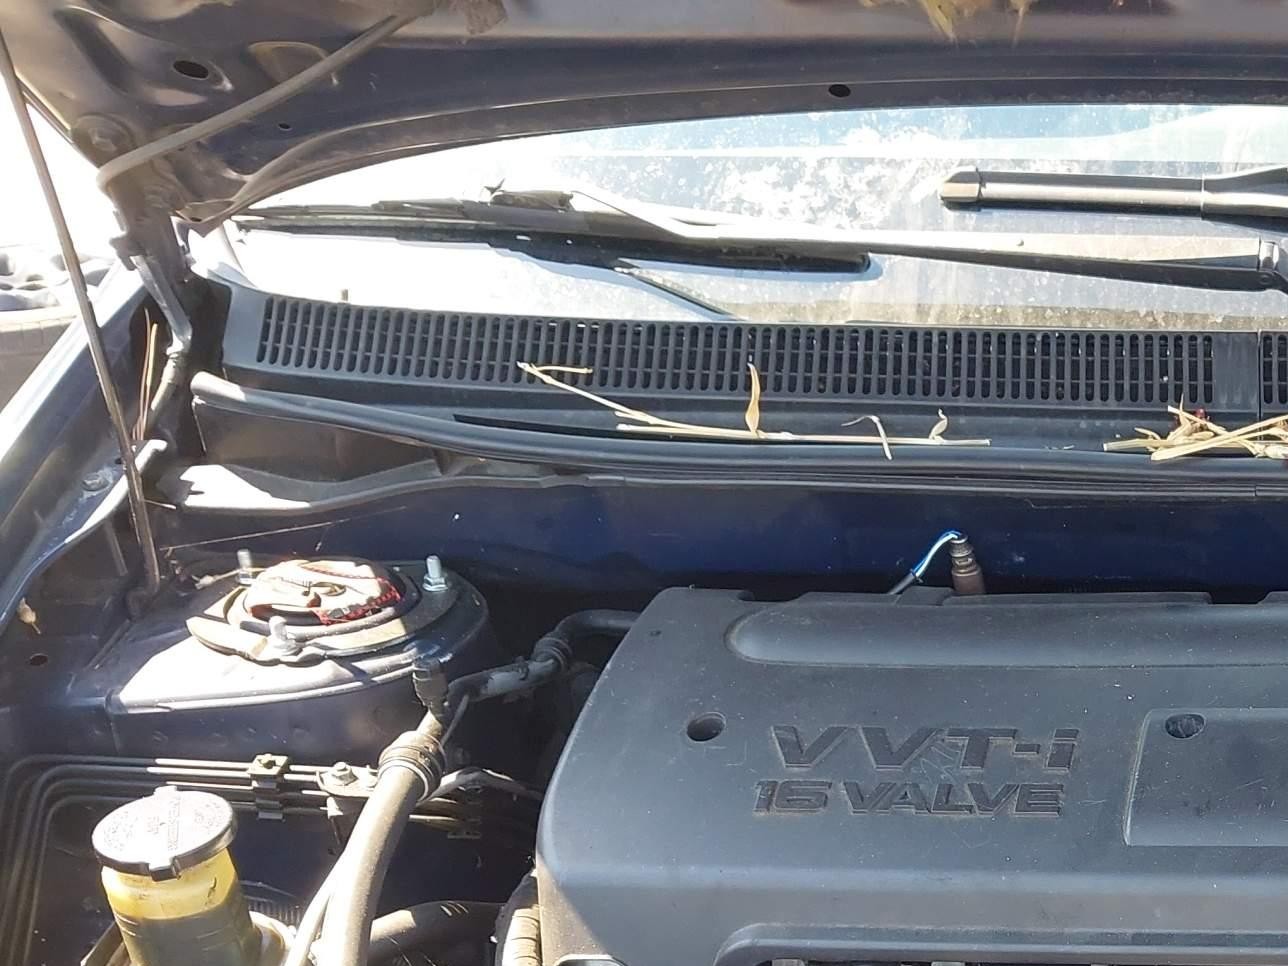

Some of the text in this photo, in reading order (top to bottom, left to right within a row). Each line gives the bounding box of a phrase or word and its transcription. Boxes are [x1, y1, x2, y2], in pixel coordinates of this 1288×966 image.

[770, 724, 1081, 773] VVT-i
[753, 778, 1066, 817] 16 VALVE
